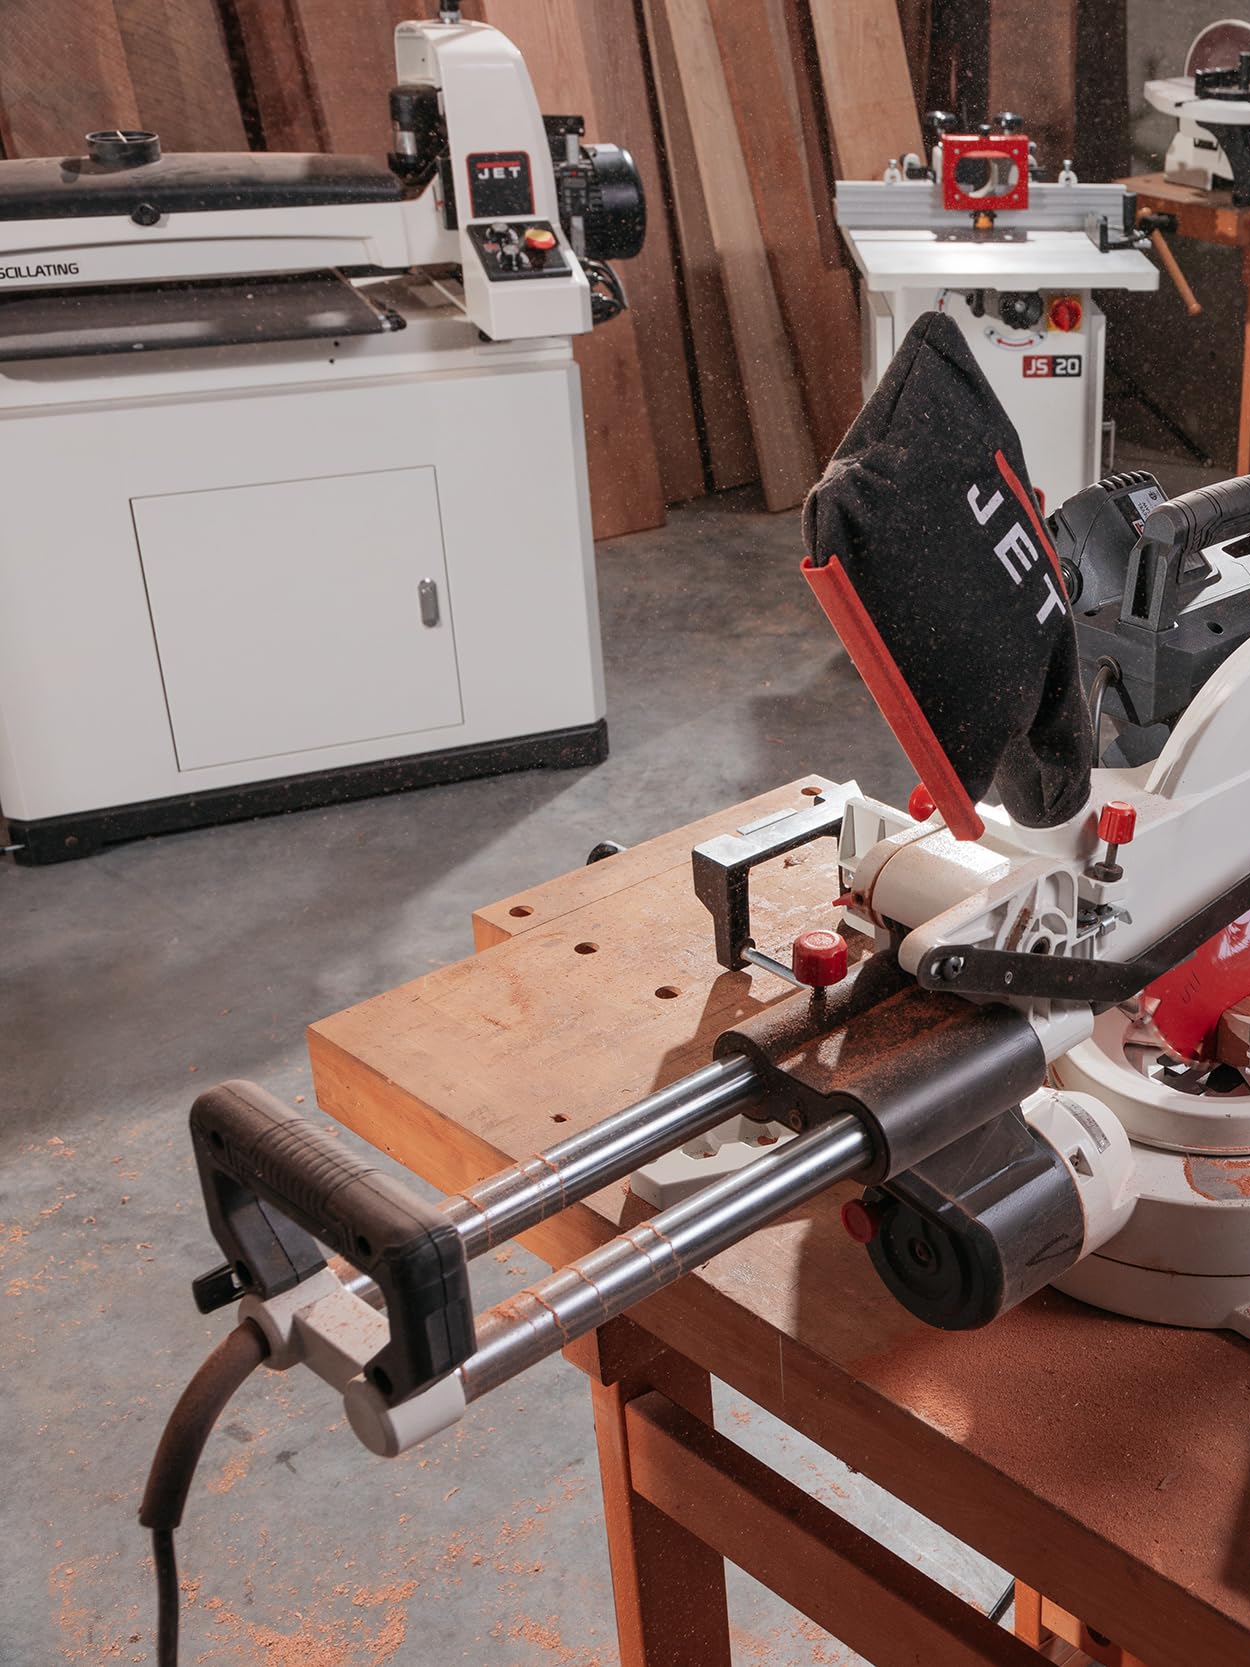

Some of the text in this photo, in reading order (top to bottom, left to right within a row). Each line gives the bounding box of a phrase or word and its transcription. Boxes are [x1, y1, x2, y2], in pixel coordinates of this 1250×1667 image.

[478, 167, 520, 179] JET
[0, 262, 79, 279] SCILLATING
[1026, 359, 1080, 375] JS 20
[967, 484, 1067, 625] JET
